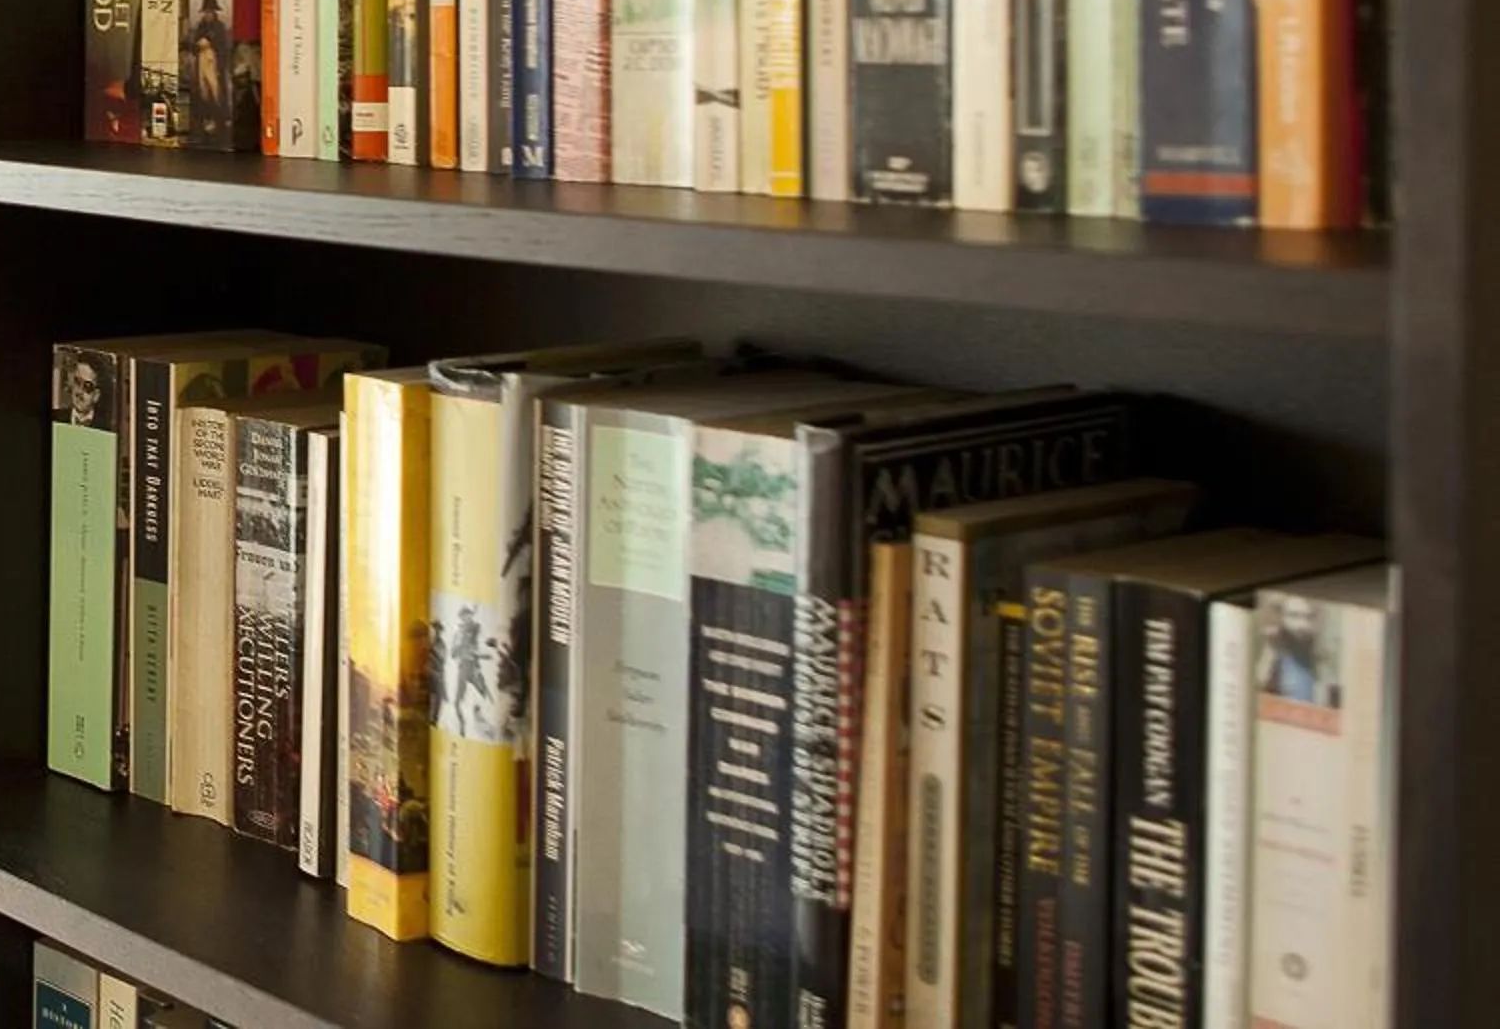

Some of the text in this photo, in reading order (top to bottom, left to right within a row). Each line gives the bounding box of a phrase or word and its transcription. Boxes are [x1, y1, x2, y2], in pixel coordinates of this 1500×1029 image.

[145, 475, 163, 543] DARKNESS
[551, 429, 572, 645] THE DEATH OF JEAN MOULIN
[864, 429, 1109, 523] MAURICE
[255, 612, 275, 741] WILLING
[810, 597, 838, 743] MAURICE
[1029, 587, 1066, 877] SOVIET EMPIRE
[1143, 617, 1175, 807] TIM PAT COOGAN
[545, 737, 565, 790] Patrick
[1068, 747, 1097, 815] FALL
[1127, 815, 1188, 1029] THE TROUB
